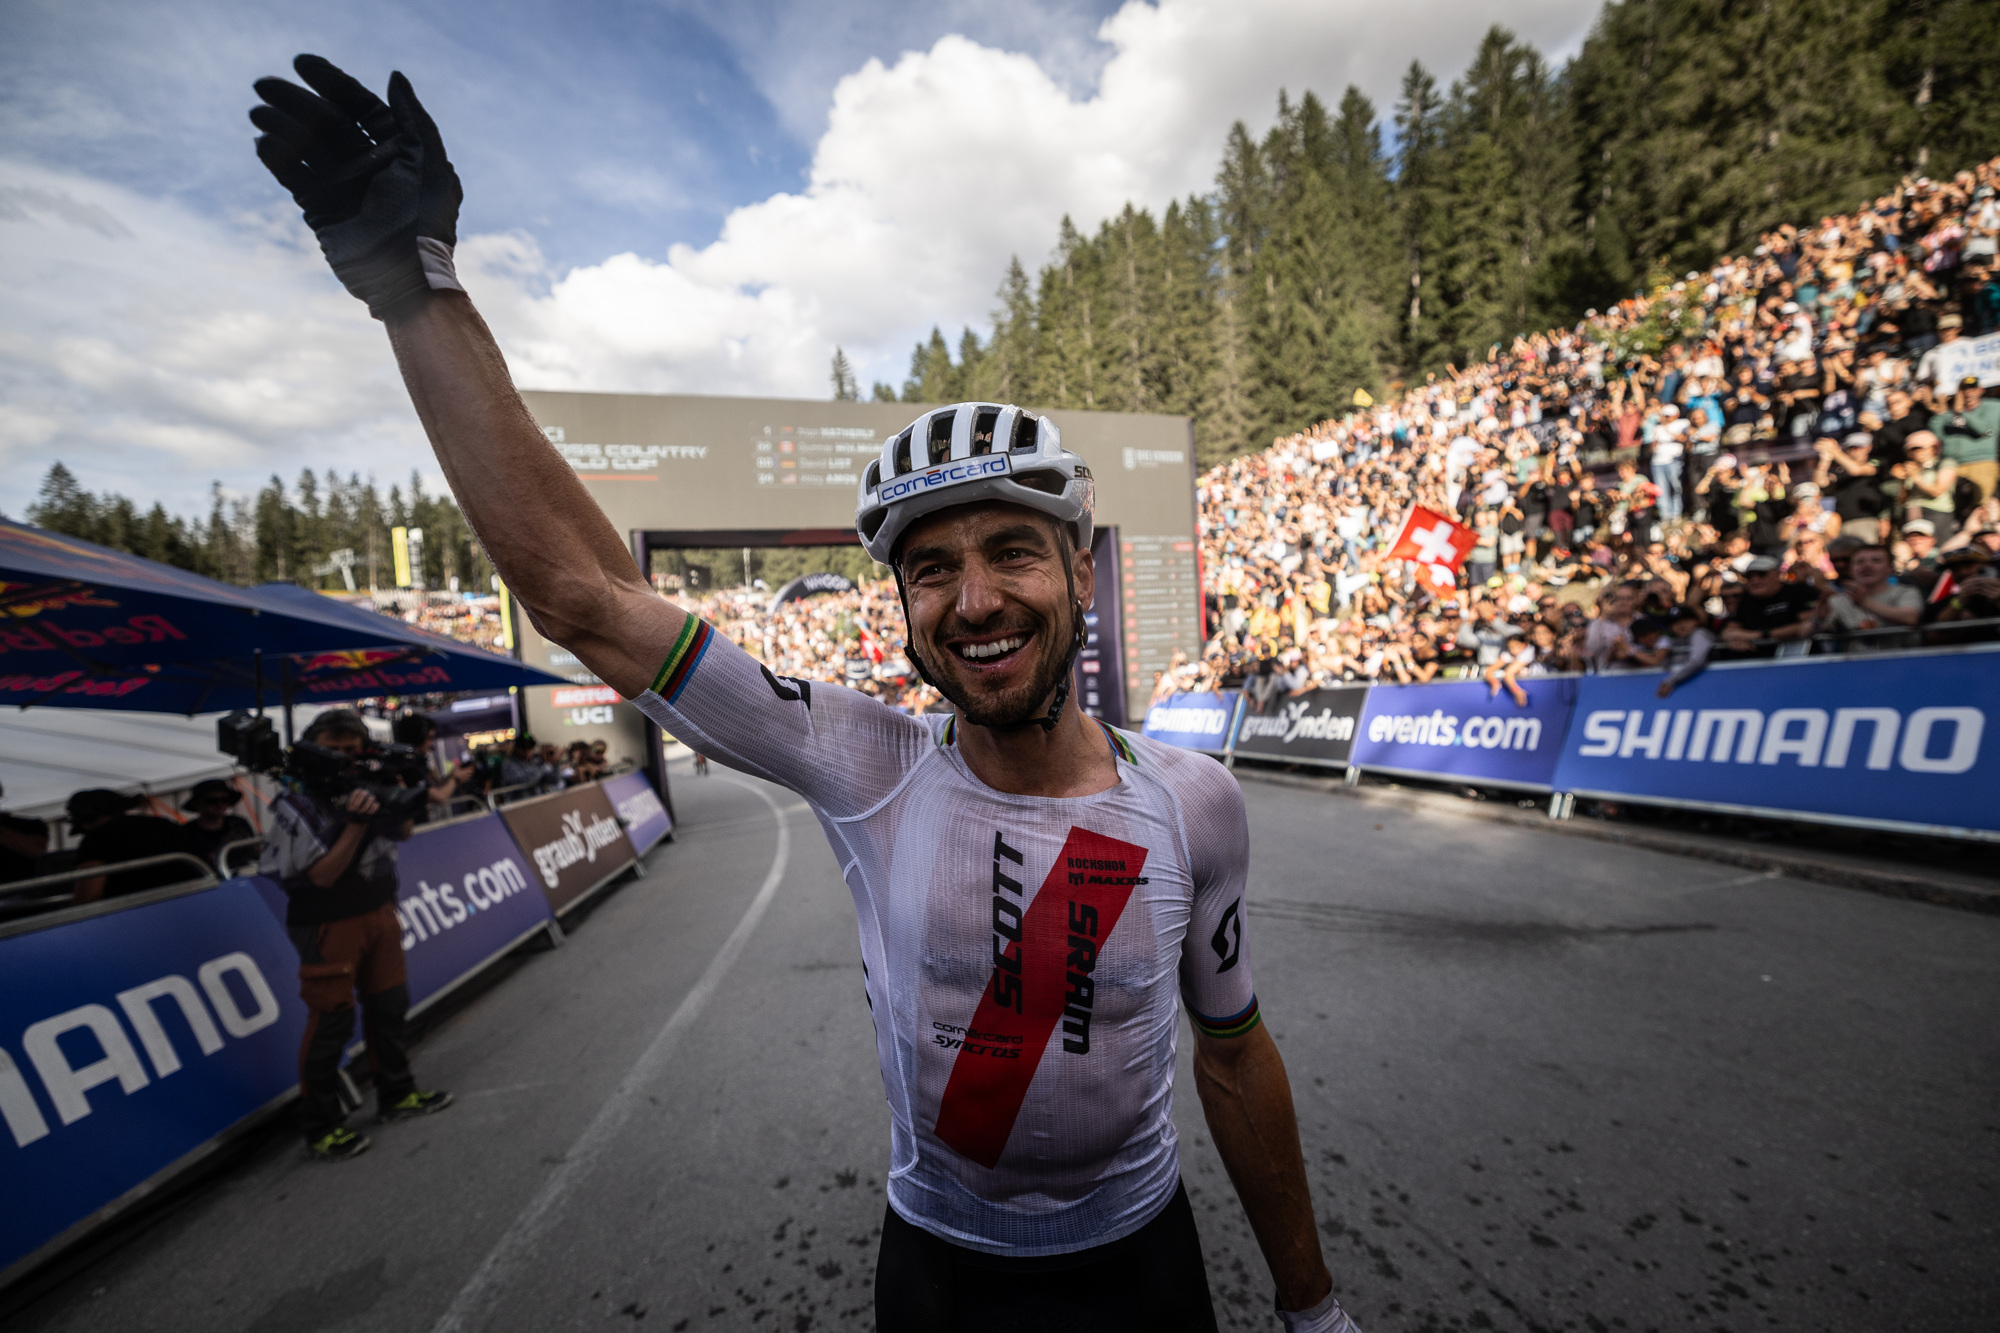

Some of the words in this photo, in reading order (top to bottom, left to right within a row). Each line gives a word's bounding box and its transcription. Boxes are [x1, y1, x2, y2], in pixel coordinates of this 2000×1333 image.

[605, 444, 707, 459] COUNTRY
[571, 705, 614, 725] UCI
[1147, 707, 1227, 735] SHIMANO
[1369, 709, 1542, 751] events.com
[1579, 706, 1986, 774] SHIMANO
[1087, 875, 1149, 886] MAXXIS
[993, 830, 1023, 1015] SCOTT
[1063, 901, 1098, 1055] SRAM
